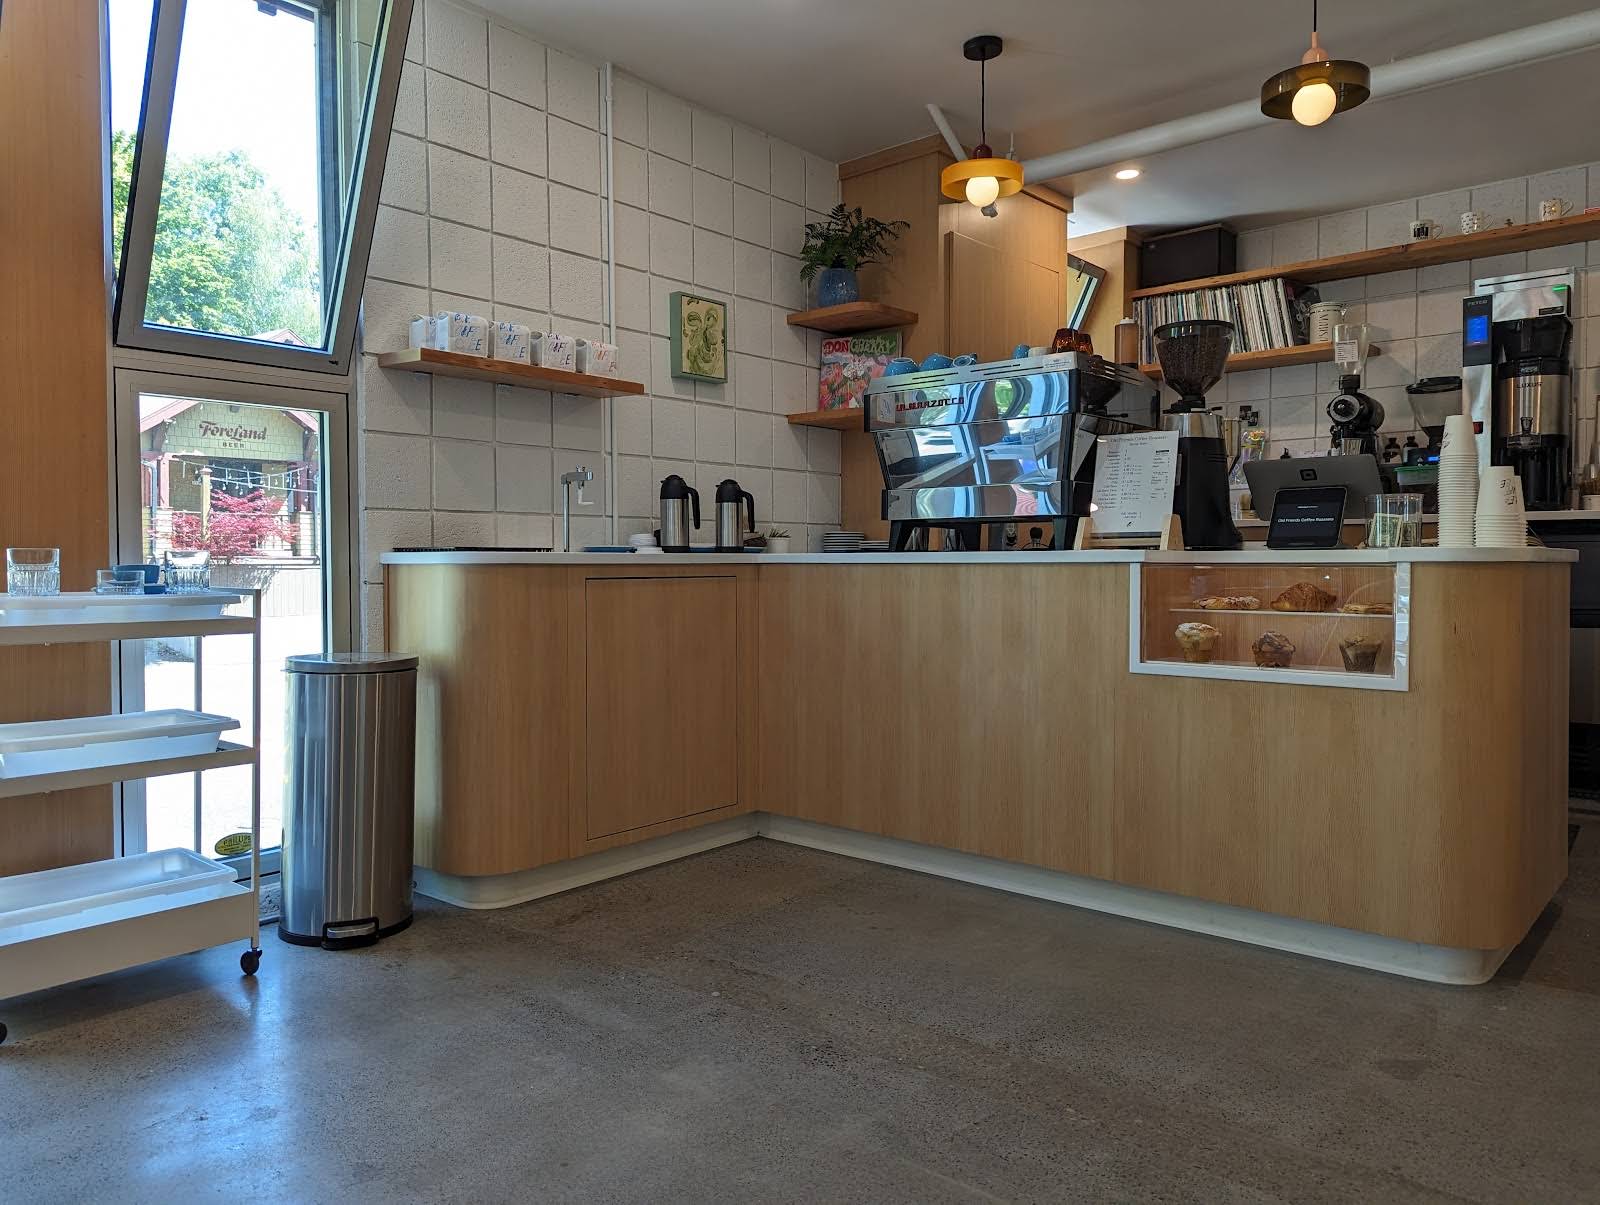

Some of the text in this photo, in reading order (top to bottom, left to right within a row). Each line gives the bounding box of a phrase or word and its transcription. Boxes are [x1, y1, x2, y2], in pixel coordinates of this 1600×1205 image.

[823, 336, 896, 355] DON CHERRY
[199, 421, 267, 442] Foreland
